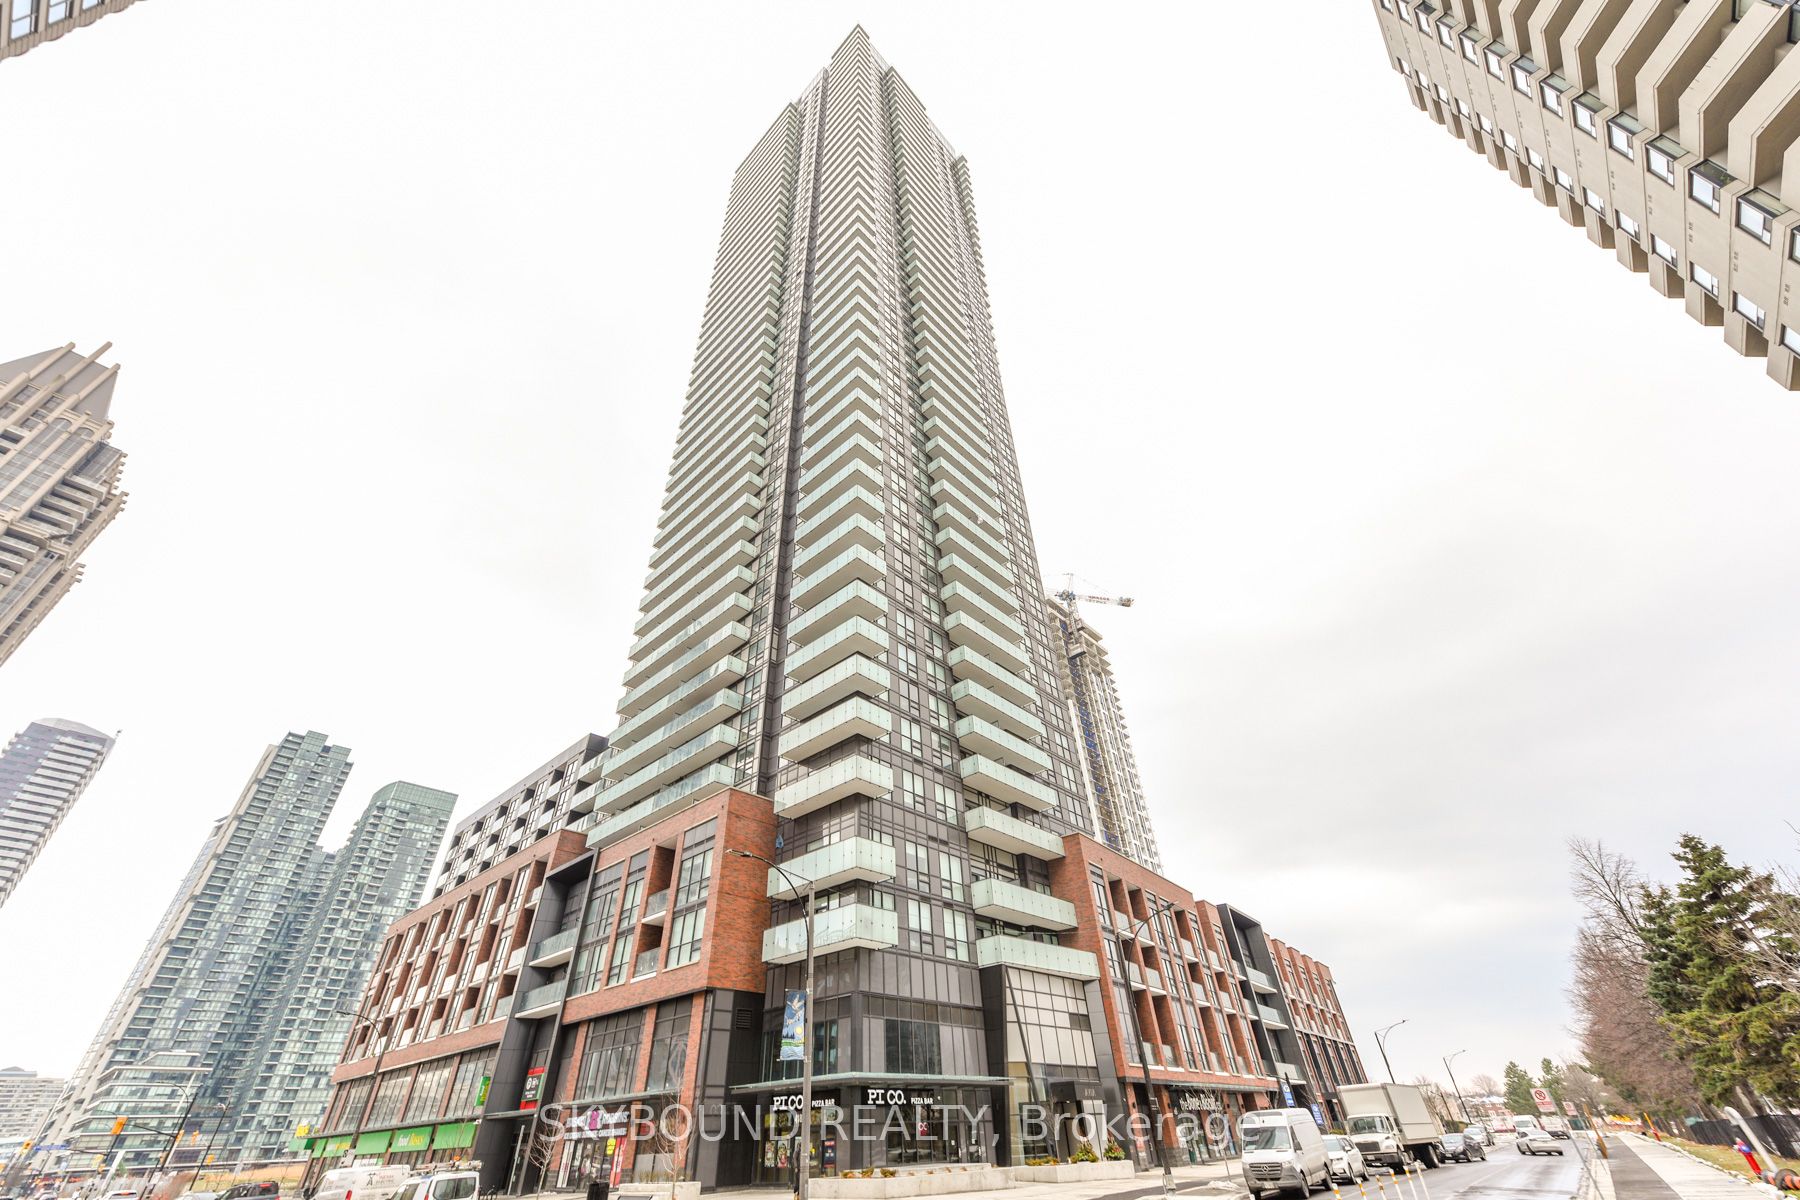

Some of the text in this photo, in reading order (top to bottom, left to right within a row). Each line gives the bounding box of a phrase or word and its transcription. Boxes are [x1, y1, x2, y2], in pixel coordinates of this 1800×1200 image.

[811, 1098, 835, 1108] PIZZA BAR
[866, 1089, 907, 1105] PI CO.
[910, 1097, 934, 1105] PIZZA BAR
[772, 1096, 788, 1111] PI
